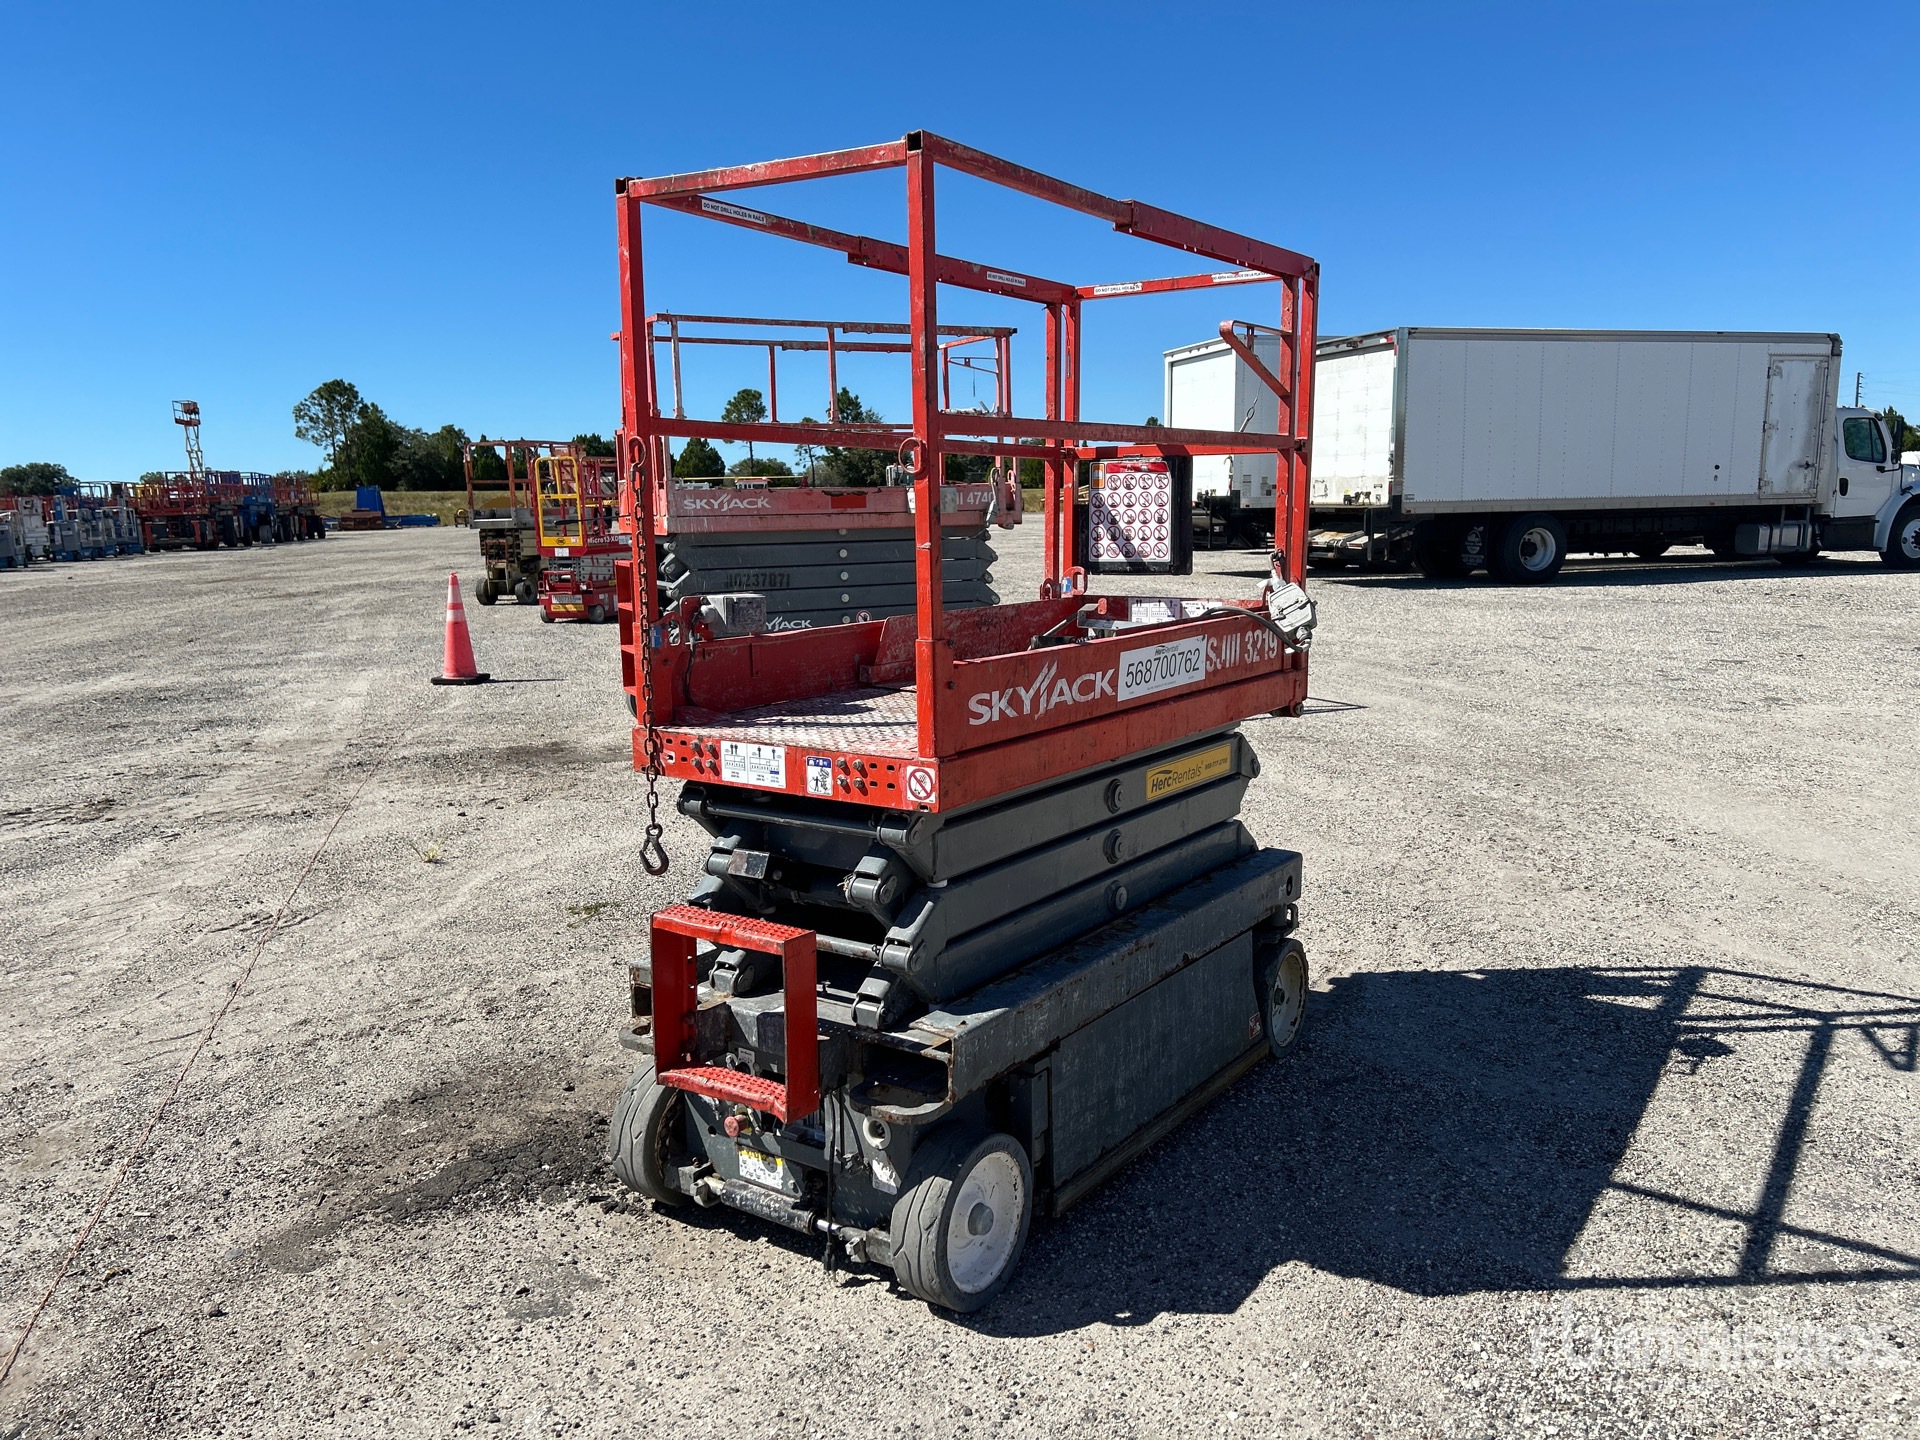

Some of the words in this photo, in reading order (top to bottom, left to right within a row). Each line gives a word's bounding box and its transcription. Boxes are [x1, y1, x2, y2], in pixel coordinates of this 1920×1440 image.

[721, 206, 732, 214] DRILL
[733, 209, 747, 218] HOLES
[753, 214, 764, 222] RAILS
[684, 493, 771, 511] SKYJACK
[766, 616, 812, 631] YJACK
[1245, 628, 1278, 664] 3219
[1125, 648, 1200, 688] 568700762
[968, 661, 1115, 725] SKYJACK
[1151, 764, 1202, 793] HercRentals
